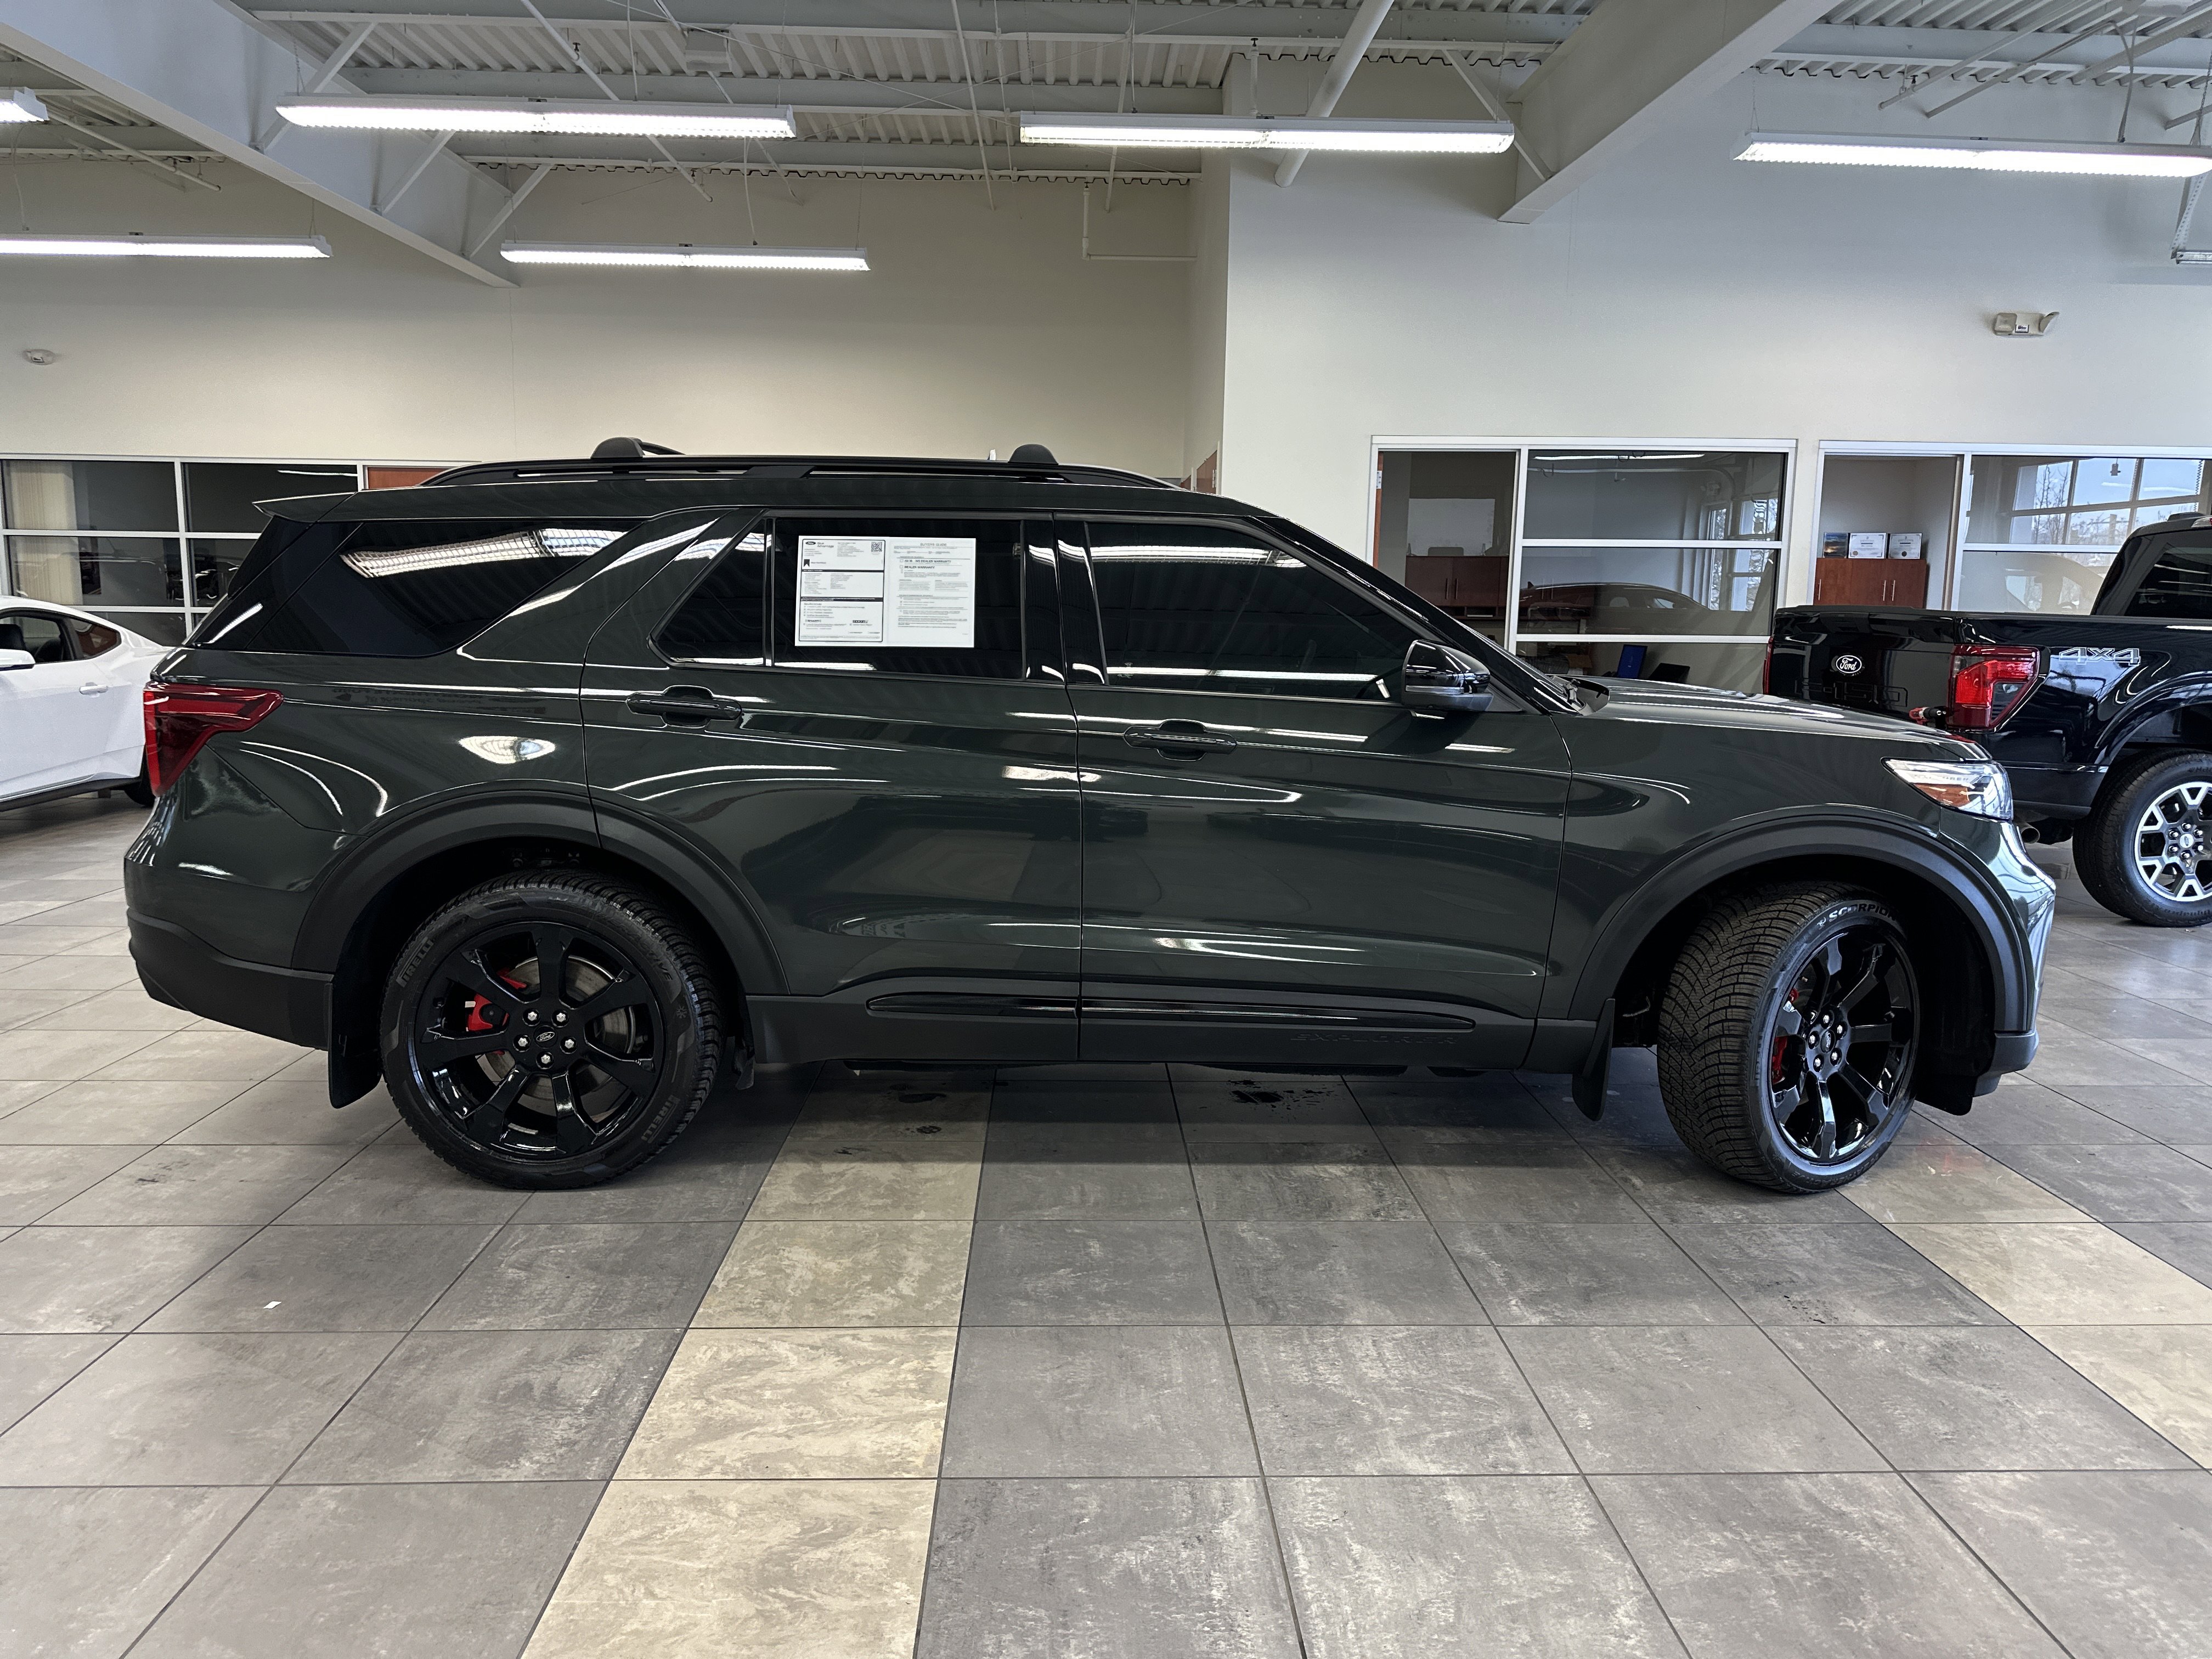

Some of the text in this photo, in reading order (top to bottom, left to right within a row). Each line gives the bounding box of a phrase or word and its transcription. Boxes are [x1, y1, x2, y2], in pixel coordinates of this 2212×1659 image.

[1839, 657, 1858, 670] Ford
[1829, 904, 1897, 922] SCORPION
[396, 937, 434, 988] PIRELLI
[1290, 1034, 1457, 1044] EXPLORER
[641, 1094, 680, 1143] PIRELLI
